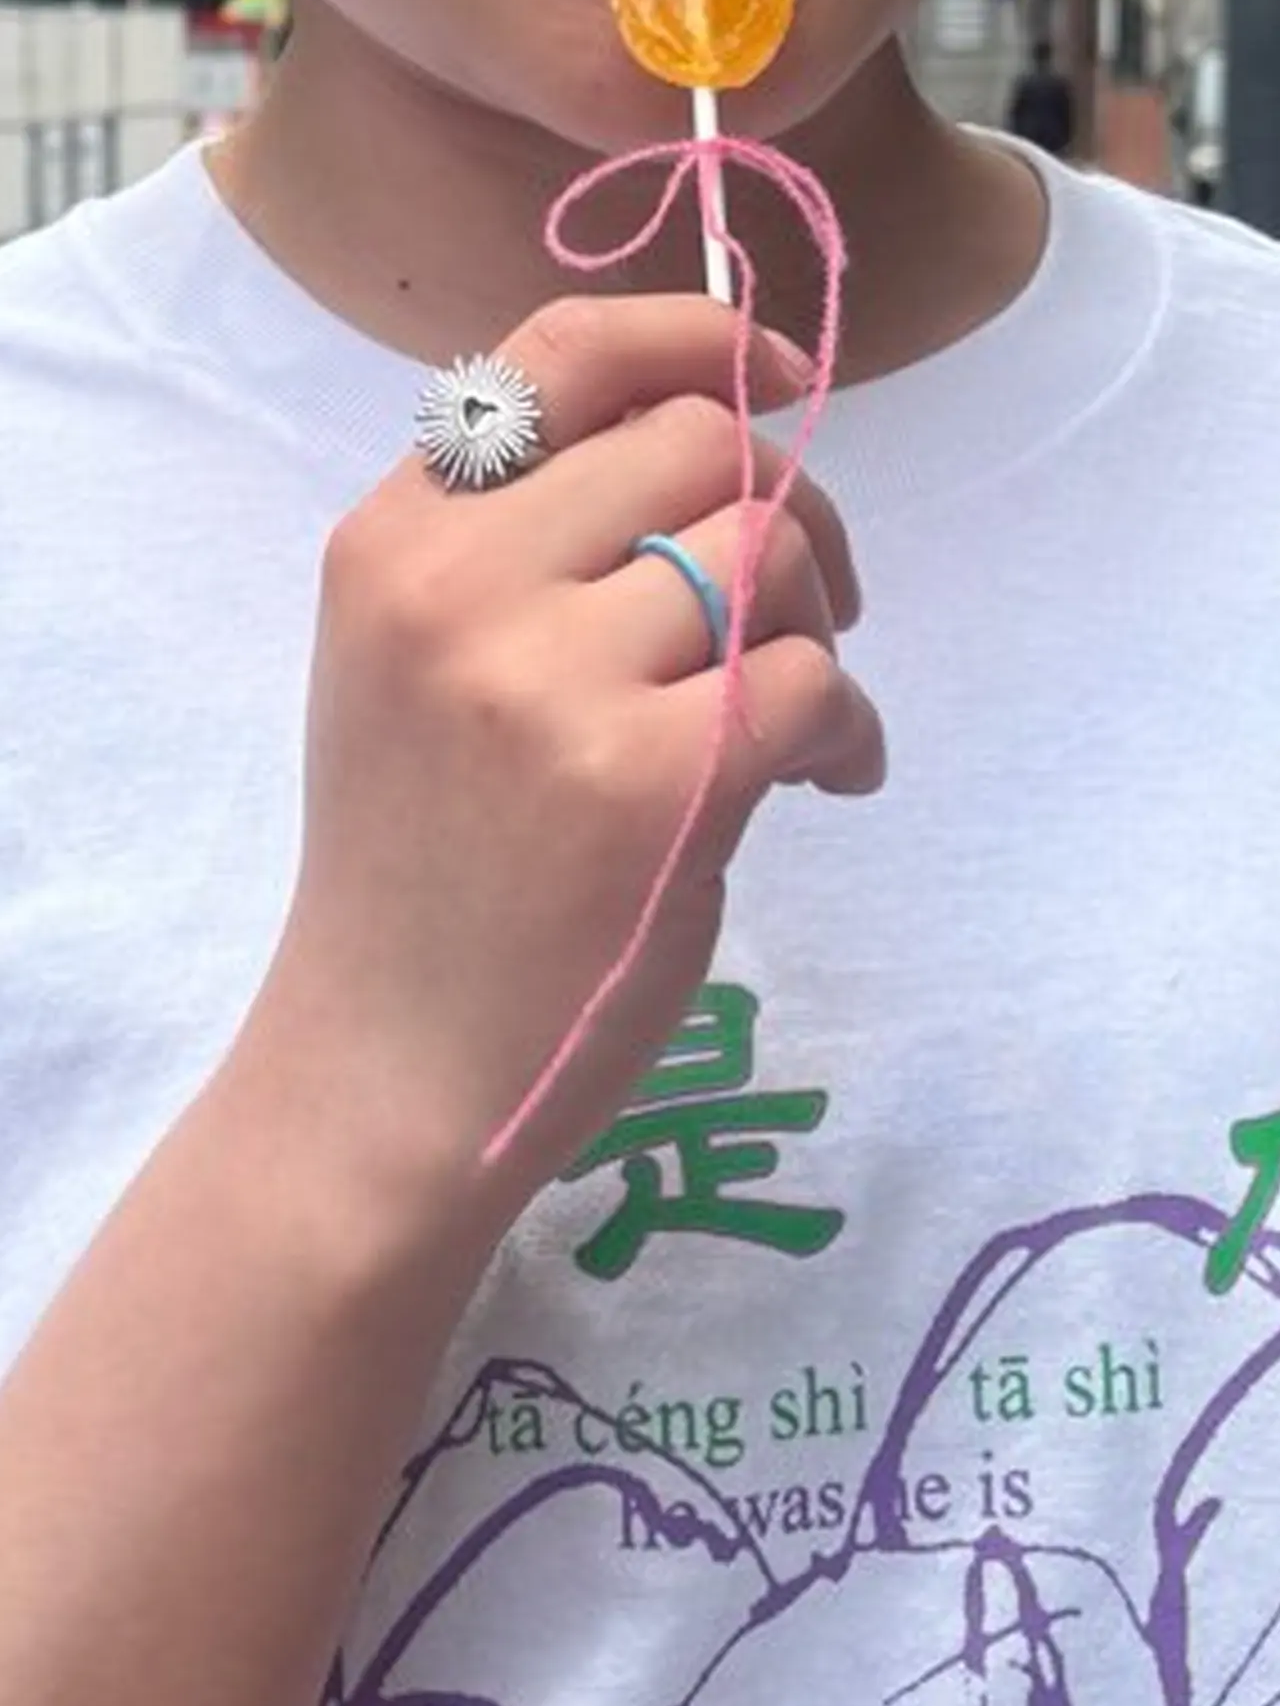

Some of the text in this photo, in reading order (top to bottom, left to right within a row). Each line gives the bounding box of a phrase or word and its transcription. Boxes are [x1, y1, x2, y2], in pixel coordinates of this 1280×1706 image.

[574, 1383, 744, 1467] céng
[770, 1361, 869, 1439] shì
[968, 1356, 1031, 1422] tā
[1065, 1339, 1164, 1420] shì
[725, 1479, 847, 1539] was
[977, 1449, 1035, 1520] is
